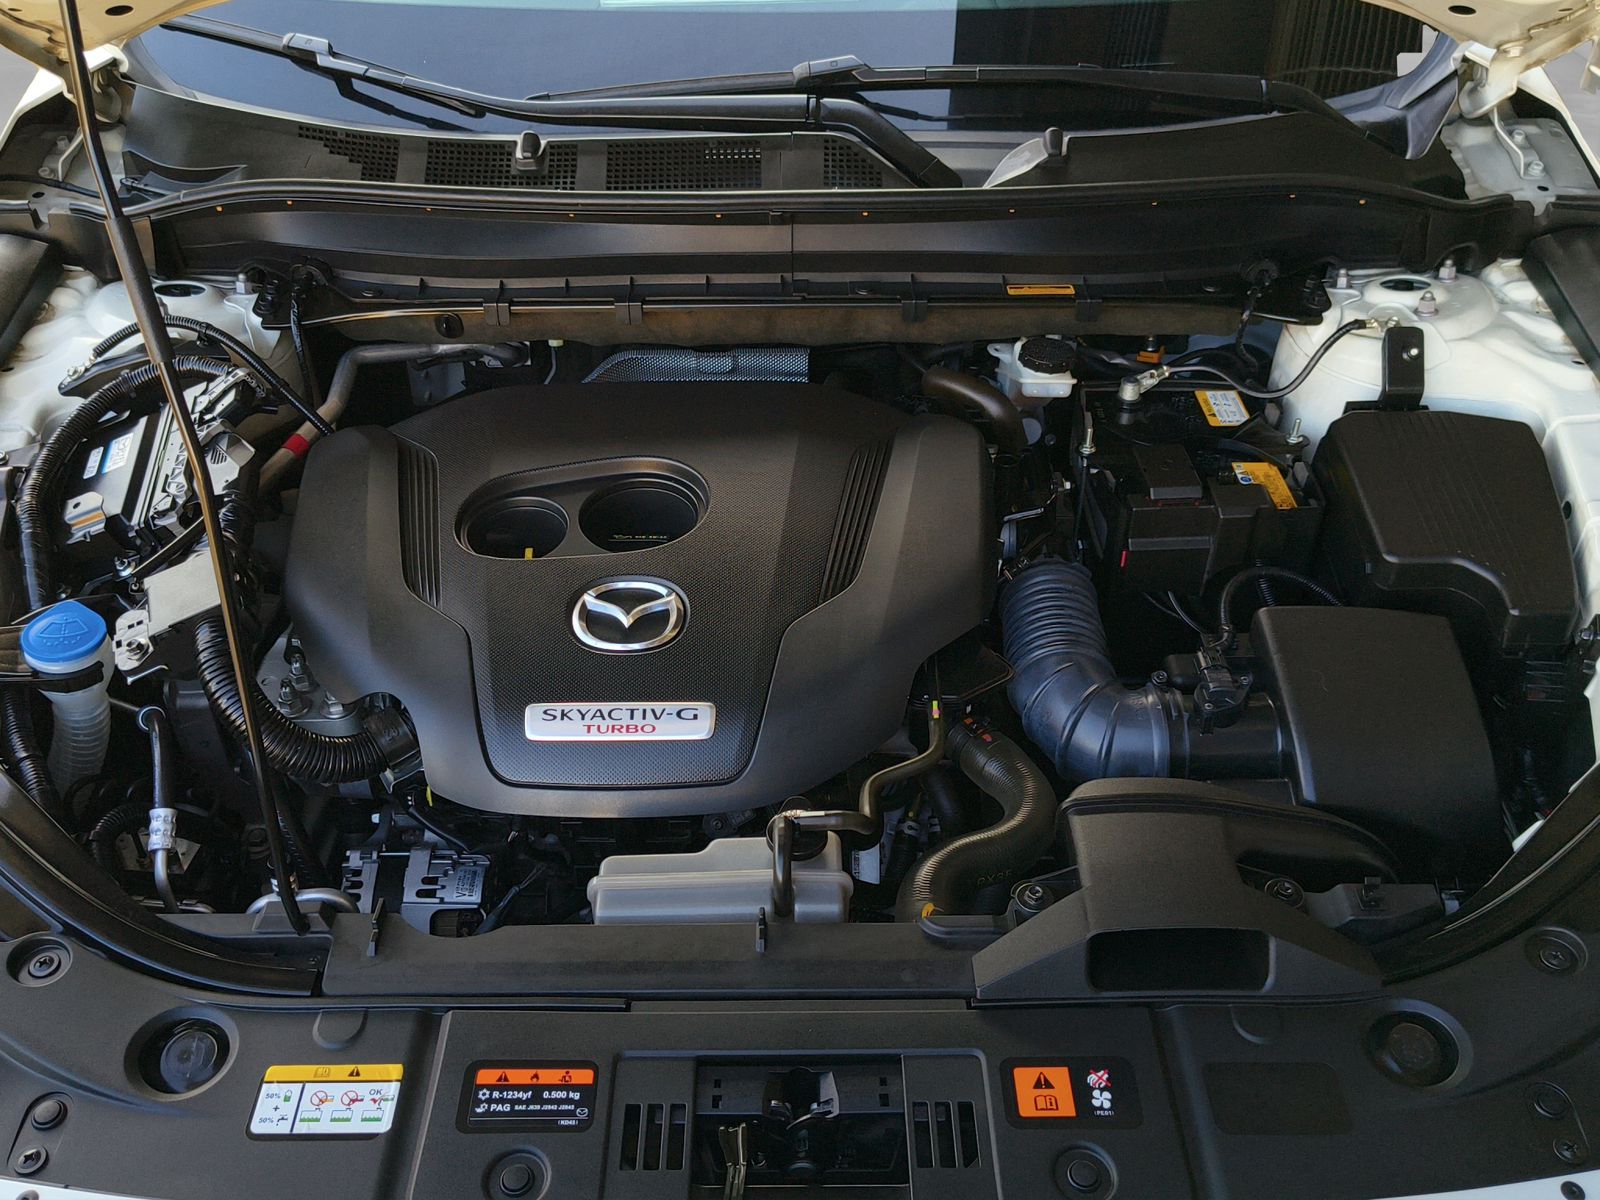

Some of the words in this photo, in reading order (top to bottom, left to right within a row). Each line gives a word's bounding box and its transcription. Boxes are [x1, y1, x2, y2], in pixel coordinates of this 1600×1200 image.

[541, 707, 699, 722] SKYACTIV-G
[582, 724, 657, 735] TURBO
[265, 1092, 281, 1100] 50%
[368, 1088, 384, 1096] OK
[492, 1090, 532, 1100] R-1234yf
[543, 1091, 567, 1099] 0.500
[568, 1091, 580, 1100] kg
[489, 1103, 511, 1112] PAG
[258, 1116, 274, 1124] 50%
